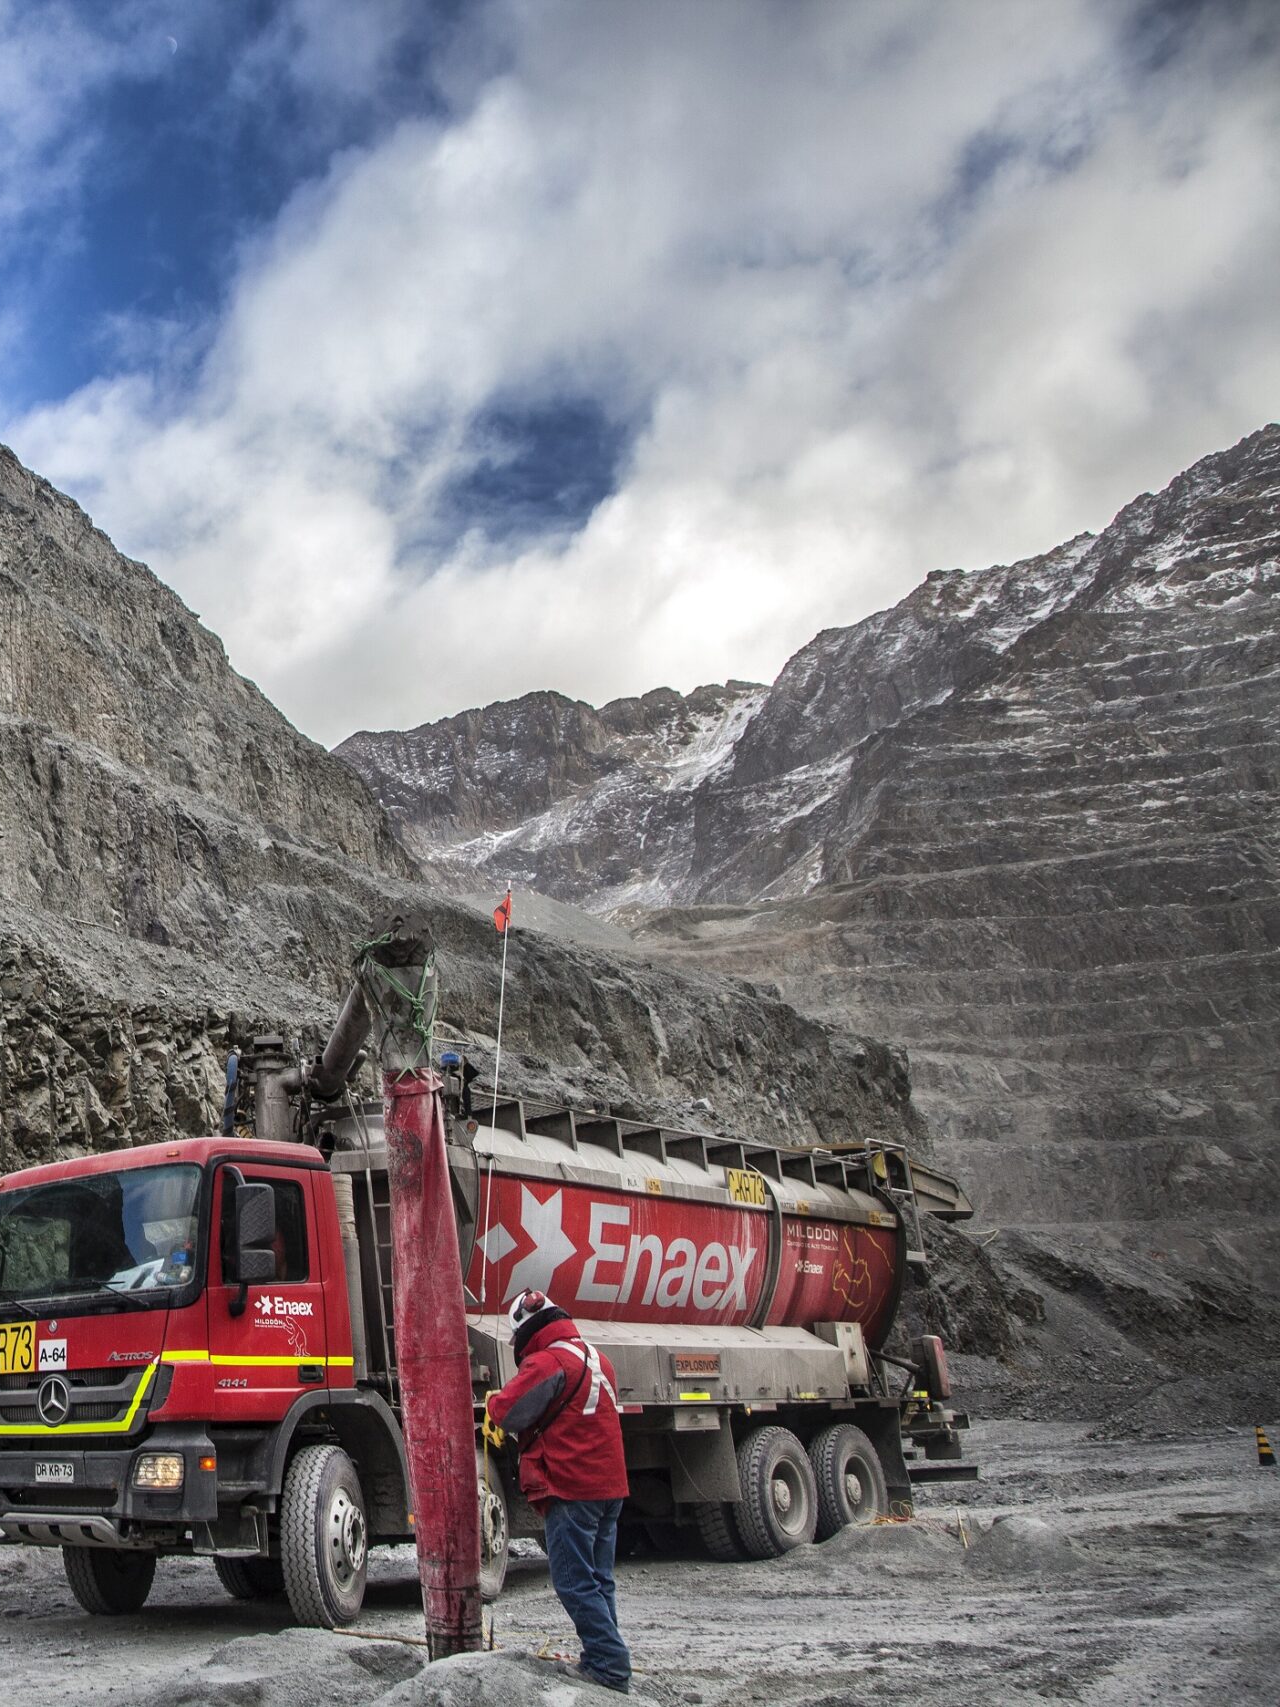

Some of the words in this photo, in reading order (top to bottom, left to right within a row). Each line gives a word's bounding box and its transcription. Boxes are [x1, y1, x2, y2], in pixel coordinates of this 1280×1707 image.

[786, 1223, 839, 1242] MILODÓN
[575, 1201, 758, 1311] Enaex
[803, 1260, 823, 1275] Enaex
[274, 1296, 313, 1316] Enaex
[40, 1347, 66, 1363] A-64
[676, 1360, 720, 1371] EXPLOSIVOS
[218, 1378, 248, 1387] 4144
